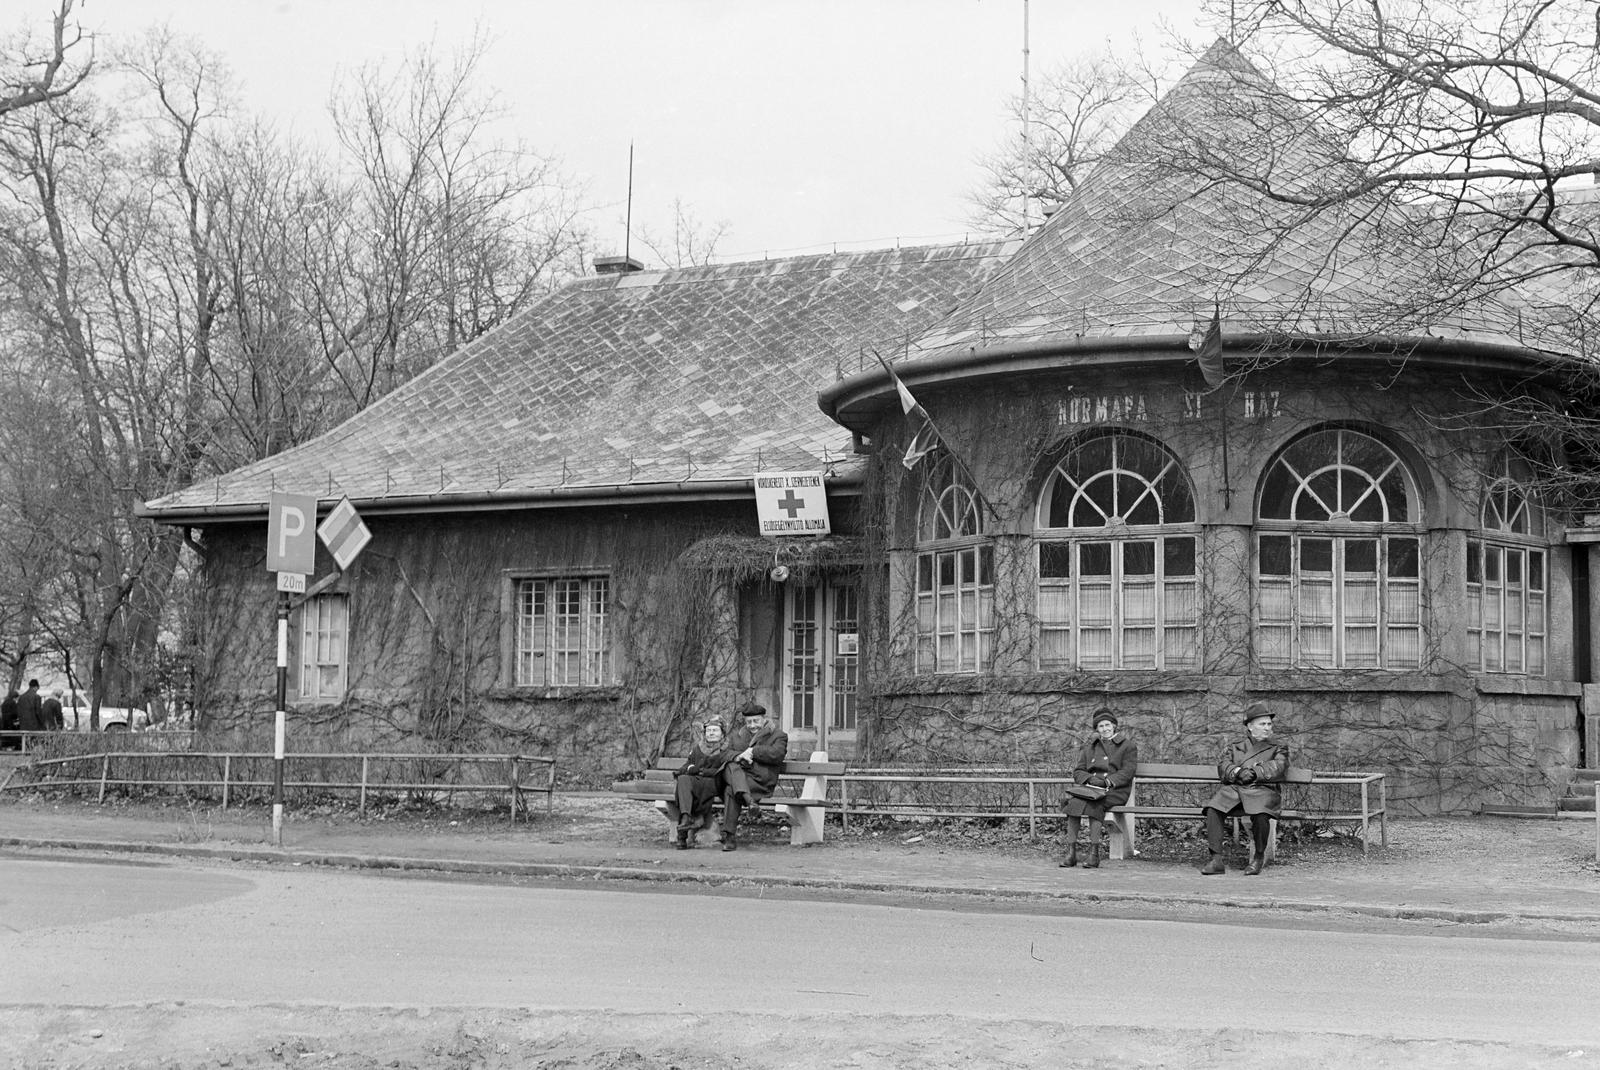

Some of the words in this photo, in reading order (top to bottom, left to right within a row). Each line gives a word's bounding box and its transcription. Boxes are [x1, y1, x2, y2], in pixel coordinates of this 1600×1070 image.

[1058, 394, 1148, 426] NORMAFA
[279, 505, 306, 557] P
[283, 575, 304, 590] 20m
